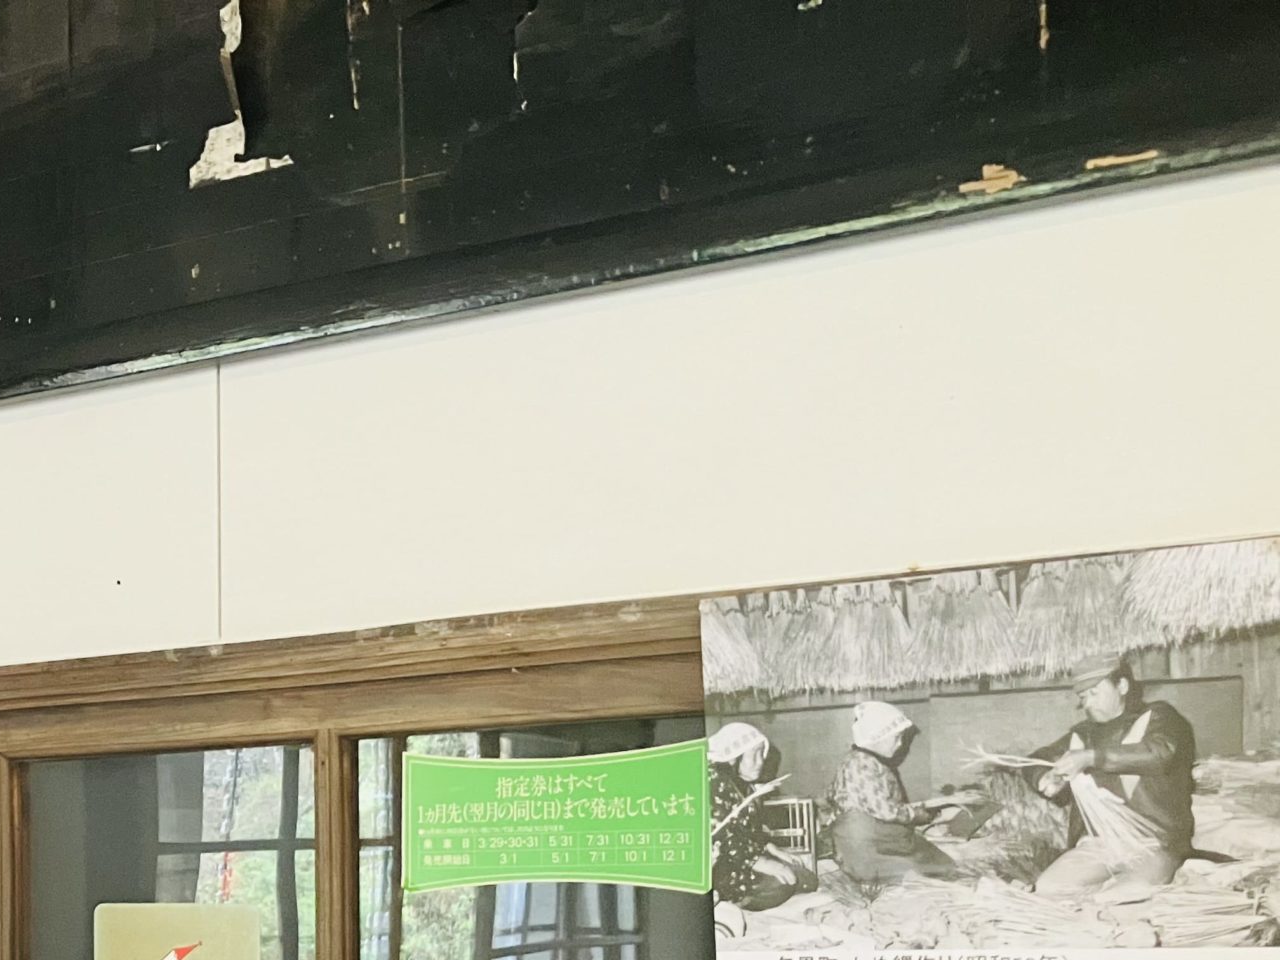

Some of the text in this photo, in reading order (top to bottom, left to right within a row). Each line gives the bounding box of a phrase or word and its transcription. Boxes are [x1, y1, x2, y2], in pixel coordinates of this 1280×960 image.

[496, 773, 608, 799] 指定券はすべて
